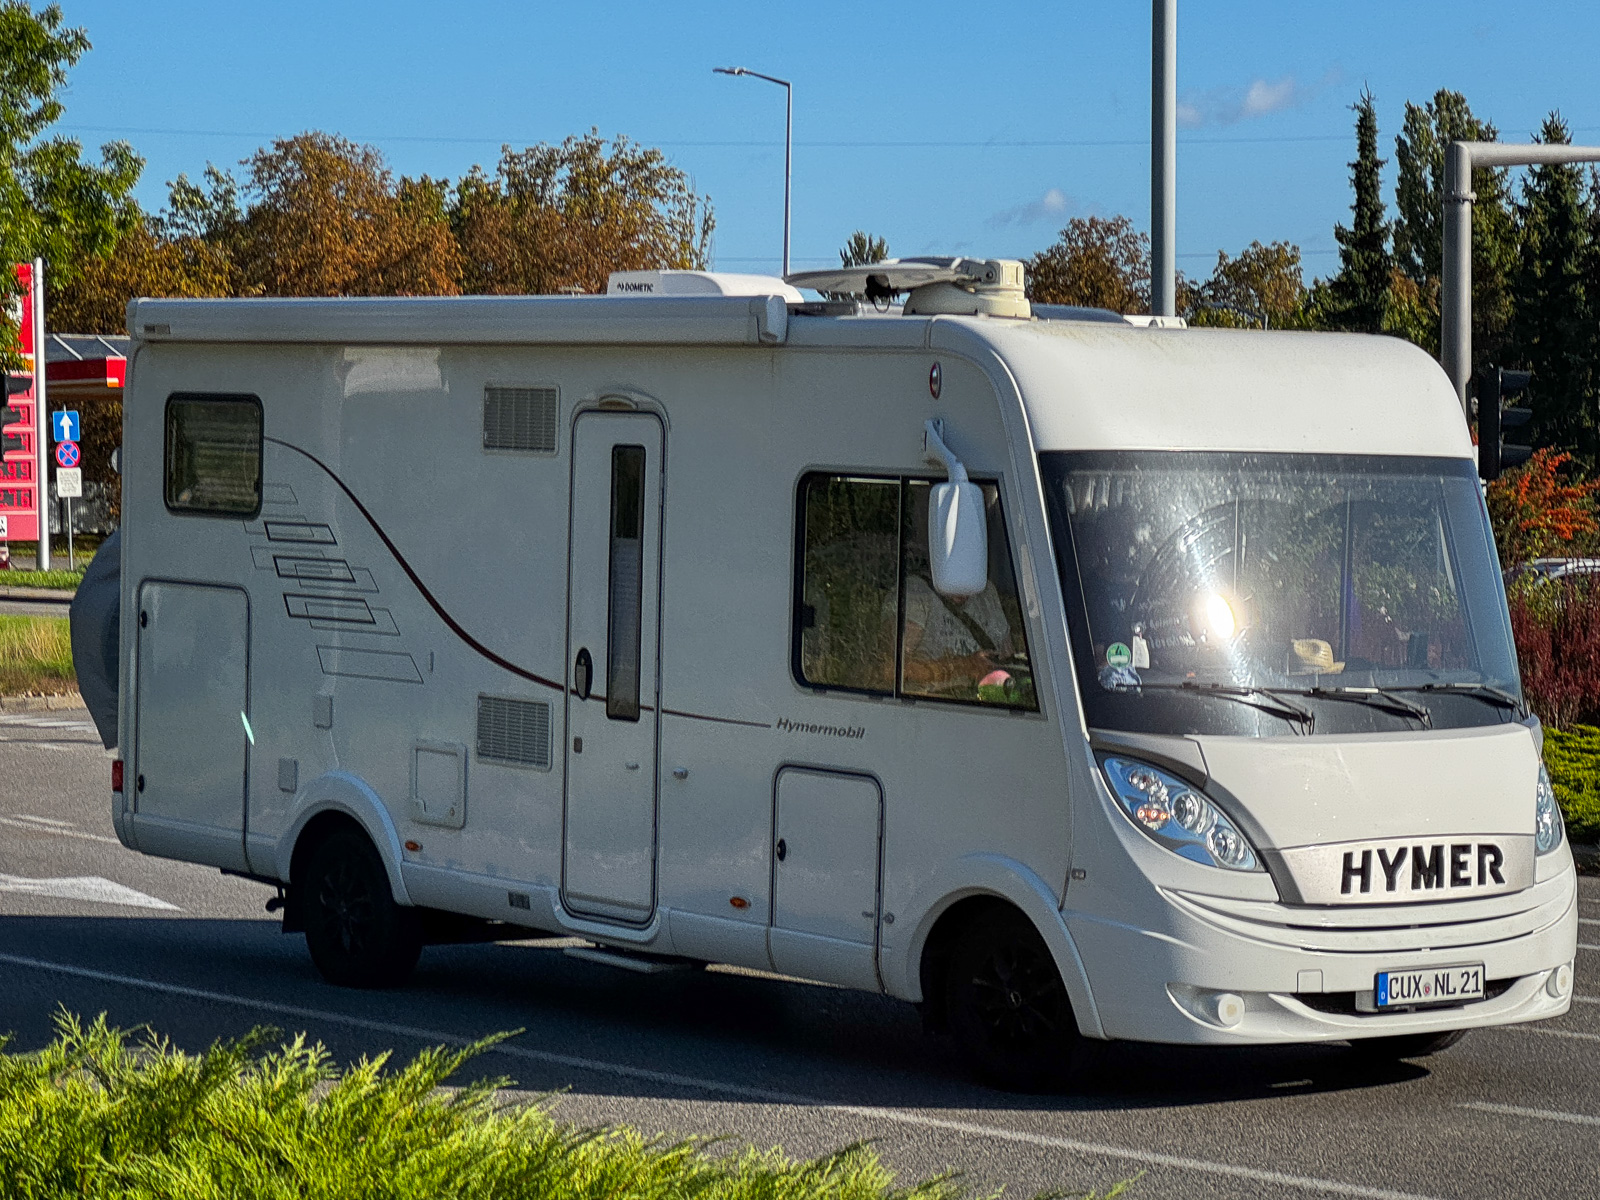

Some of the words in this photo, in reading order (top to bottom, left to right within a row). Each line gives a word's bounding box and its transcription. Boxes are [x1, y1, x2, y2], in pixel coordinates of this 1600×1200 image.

[625, 282, 654, 293] DOMETIC
[776, 717, 865, 739] Hymermobil
[1341, 844, 1506, 894] HYMER
[1389, 974, 1422, 1000] CUX
[1434, 972, 1457, 997] NL
[1460, 970, 1481, 994] 21
